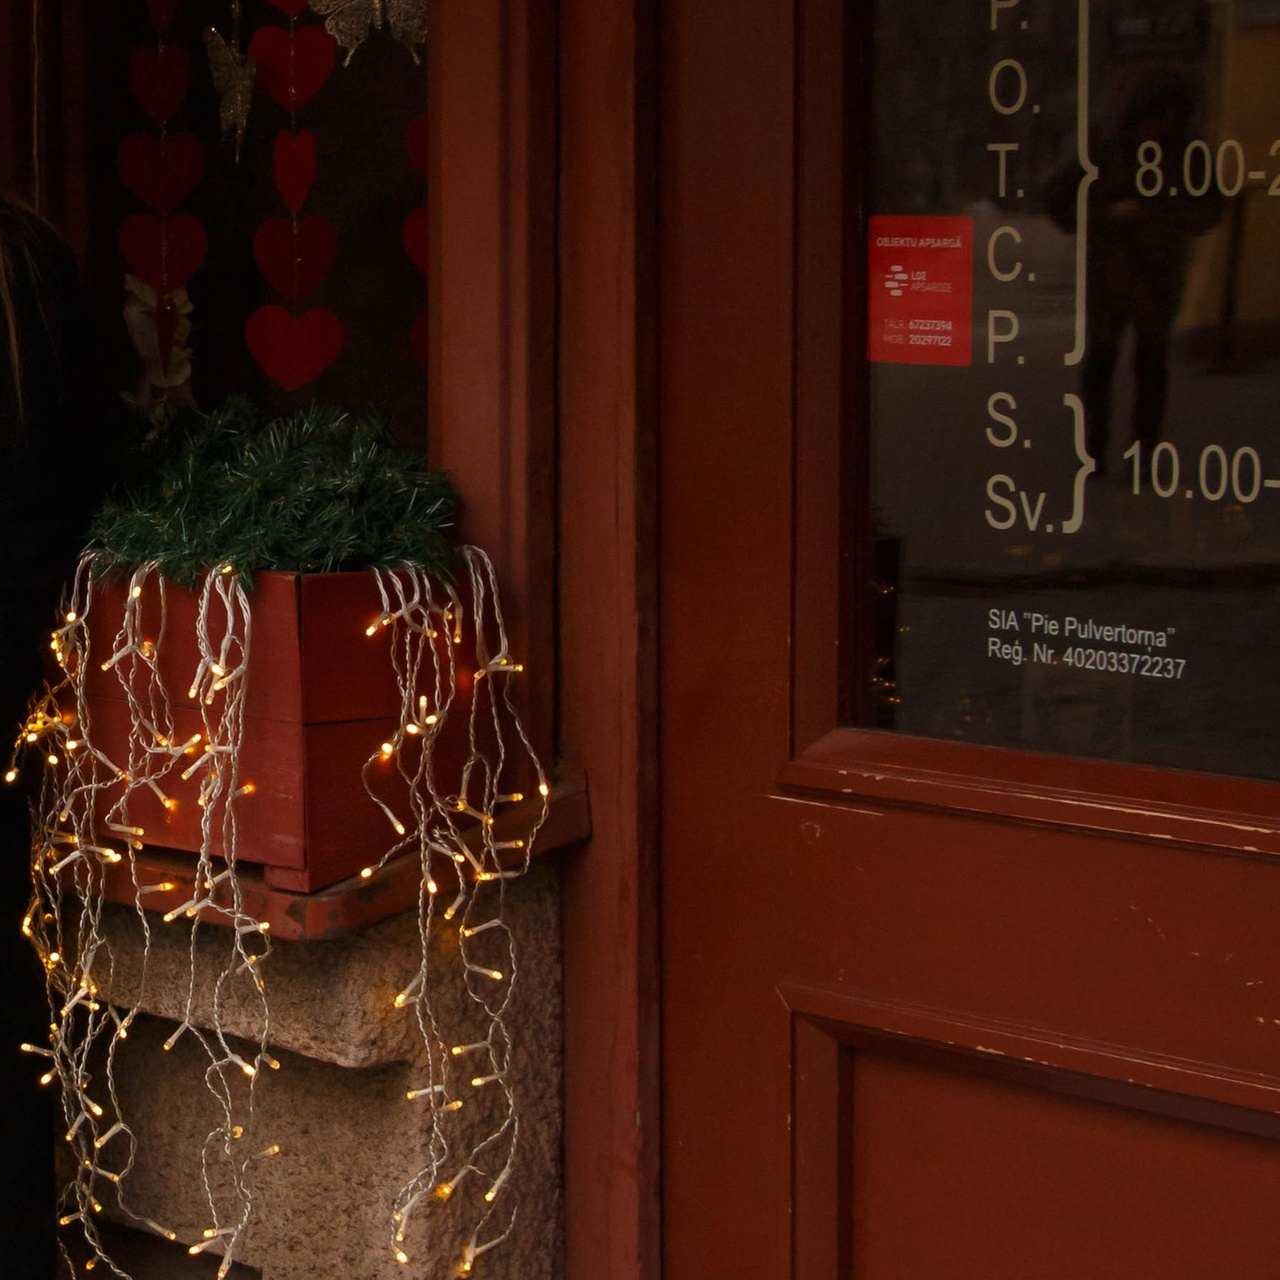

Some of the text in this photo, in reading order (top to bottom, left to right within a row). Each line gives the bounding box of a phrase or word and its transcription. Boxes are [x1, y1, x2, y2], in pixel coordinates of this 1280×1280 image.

[988, 58, 1041, 115] O.
[986, 142, 1025, 199] T.
[876, 237, 917, 247] OBJEKTU
[987, 225, 1036, 282] C.
[987, 309, 1025, 365] P.
[985, 391, 1031, 448] S.
[984, 474, 1054, 532] Sv.
[987, 608, 1020, 631] SIA
[1032, 642, 1058, 665] Nr.
[1062, 646, 1187, 680] 40203372237
